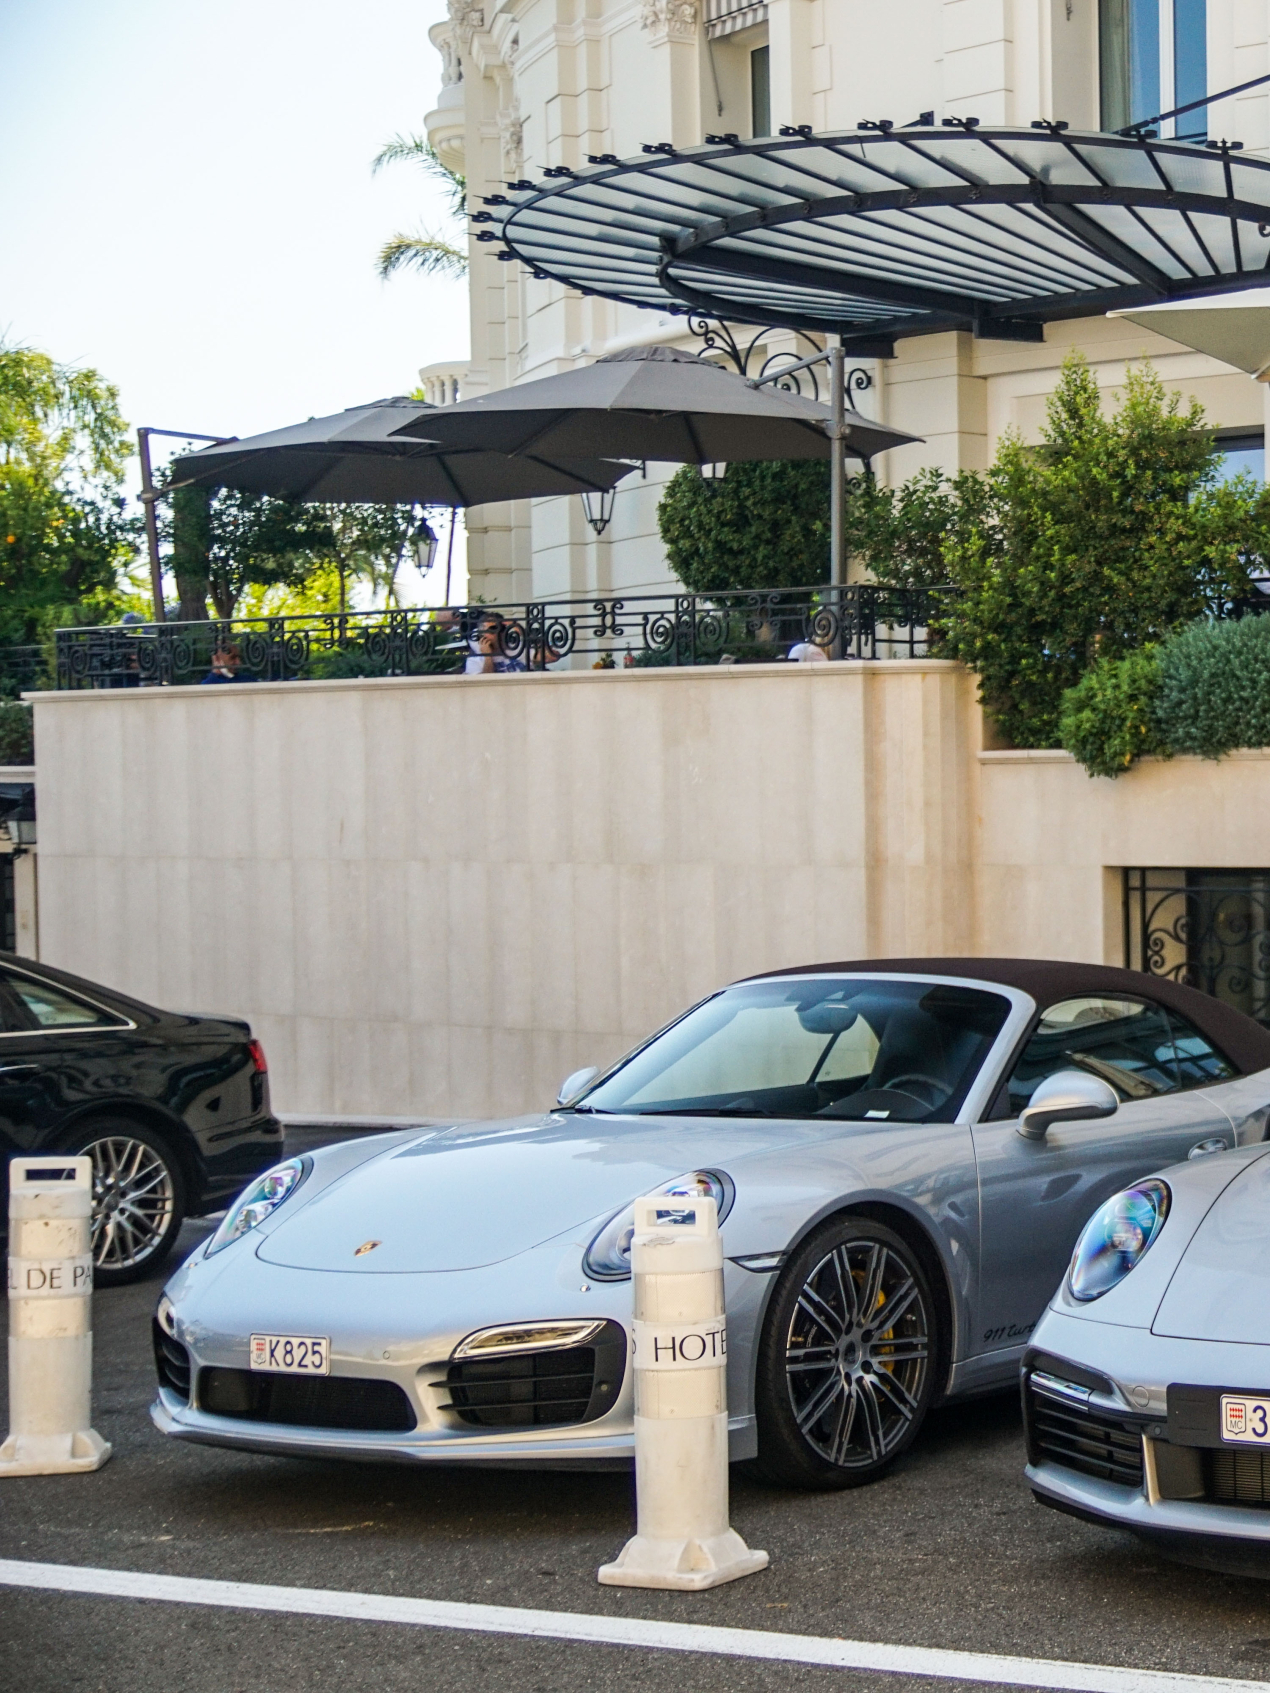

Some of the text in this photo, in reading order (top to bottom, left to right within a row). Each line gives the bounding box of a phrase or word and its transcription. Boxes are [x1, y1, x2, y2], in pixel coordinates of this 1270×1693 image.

[27, 1267, 62, 1290] DE
[983, 1326, 1006, 1343] 911
[269, 1339, 323, 1369] K825
[1229, 1420, 1243, 1430] MC
